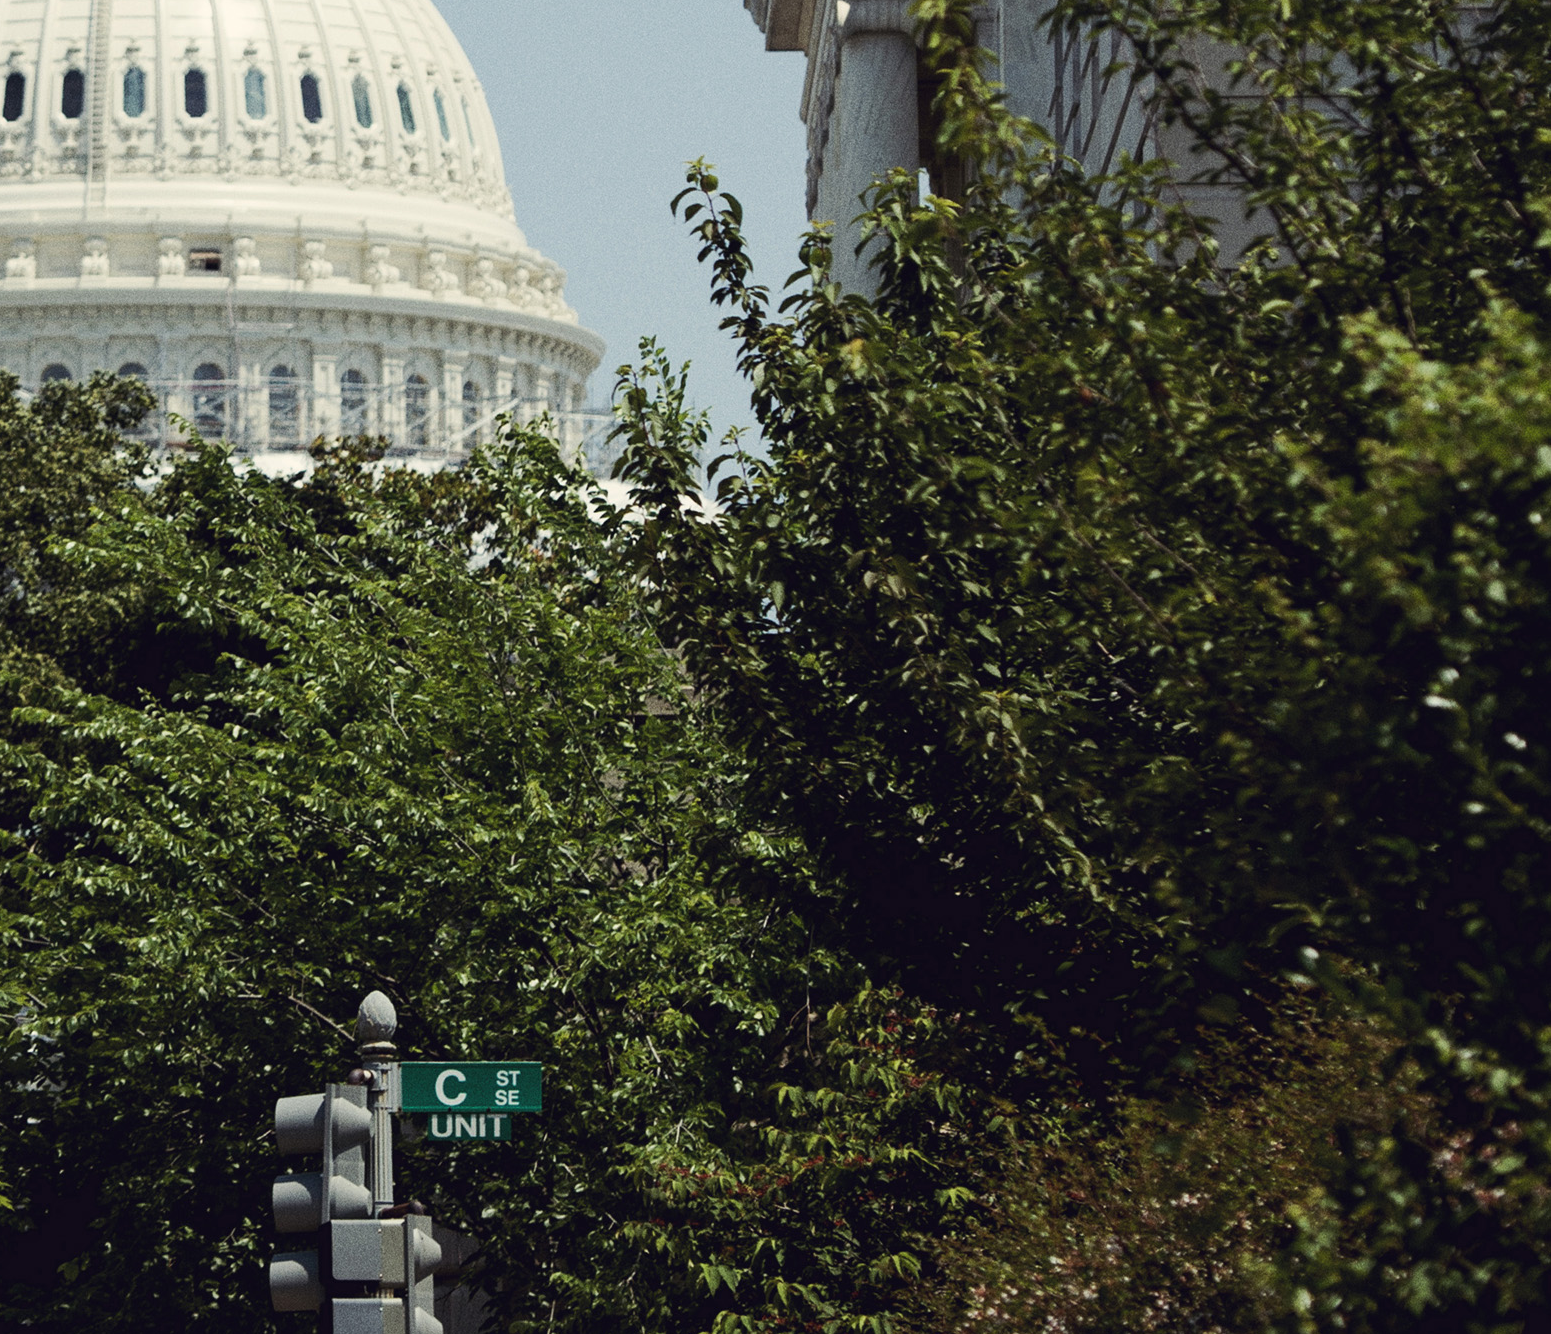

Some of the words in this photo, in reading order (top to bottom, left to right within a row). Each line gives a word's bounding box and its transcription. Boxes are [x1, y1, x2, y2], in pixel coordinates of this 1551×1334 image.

[435, 1069, 467, 1106] C
[496, 1070, 521, 1087] ST
[495, 1089, 520, 1106] SE
[431, 1114, 508, 1138] UNIT
